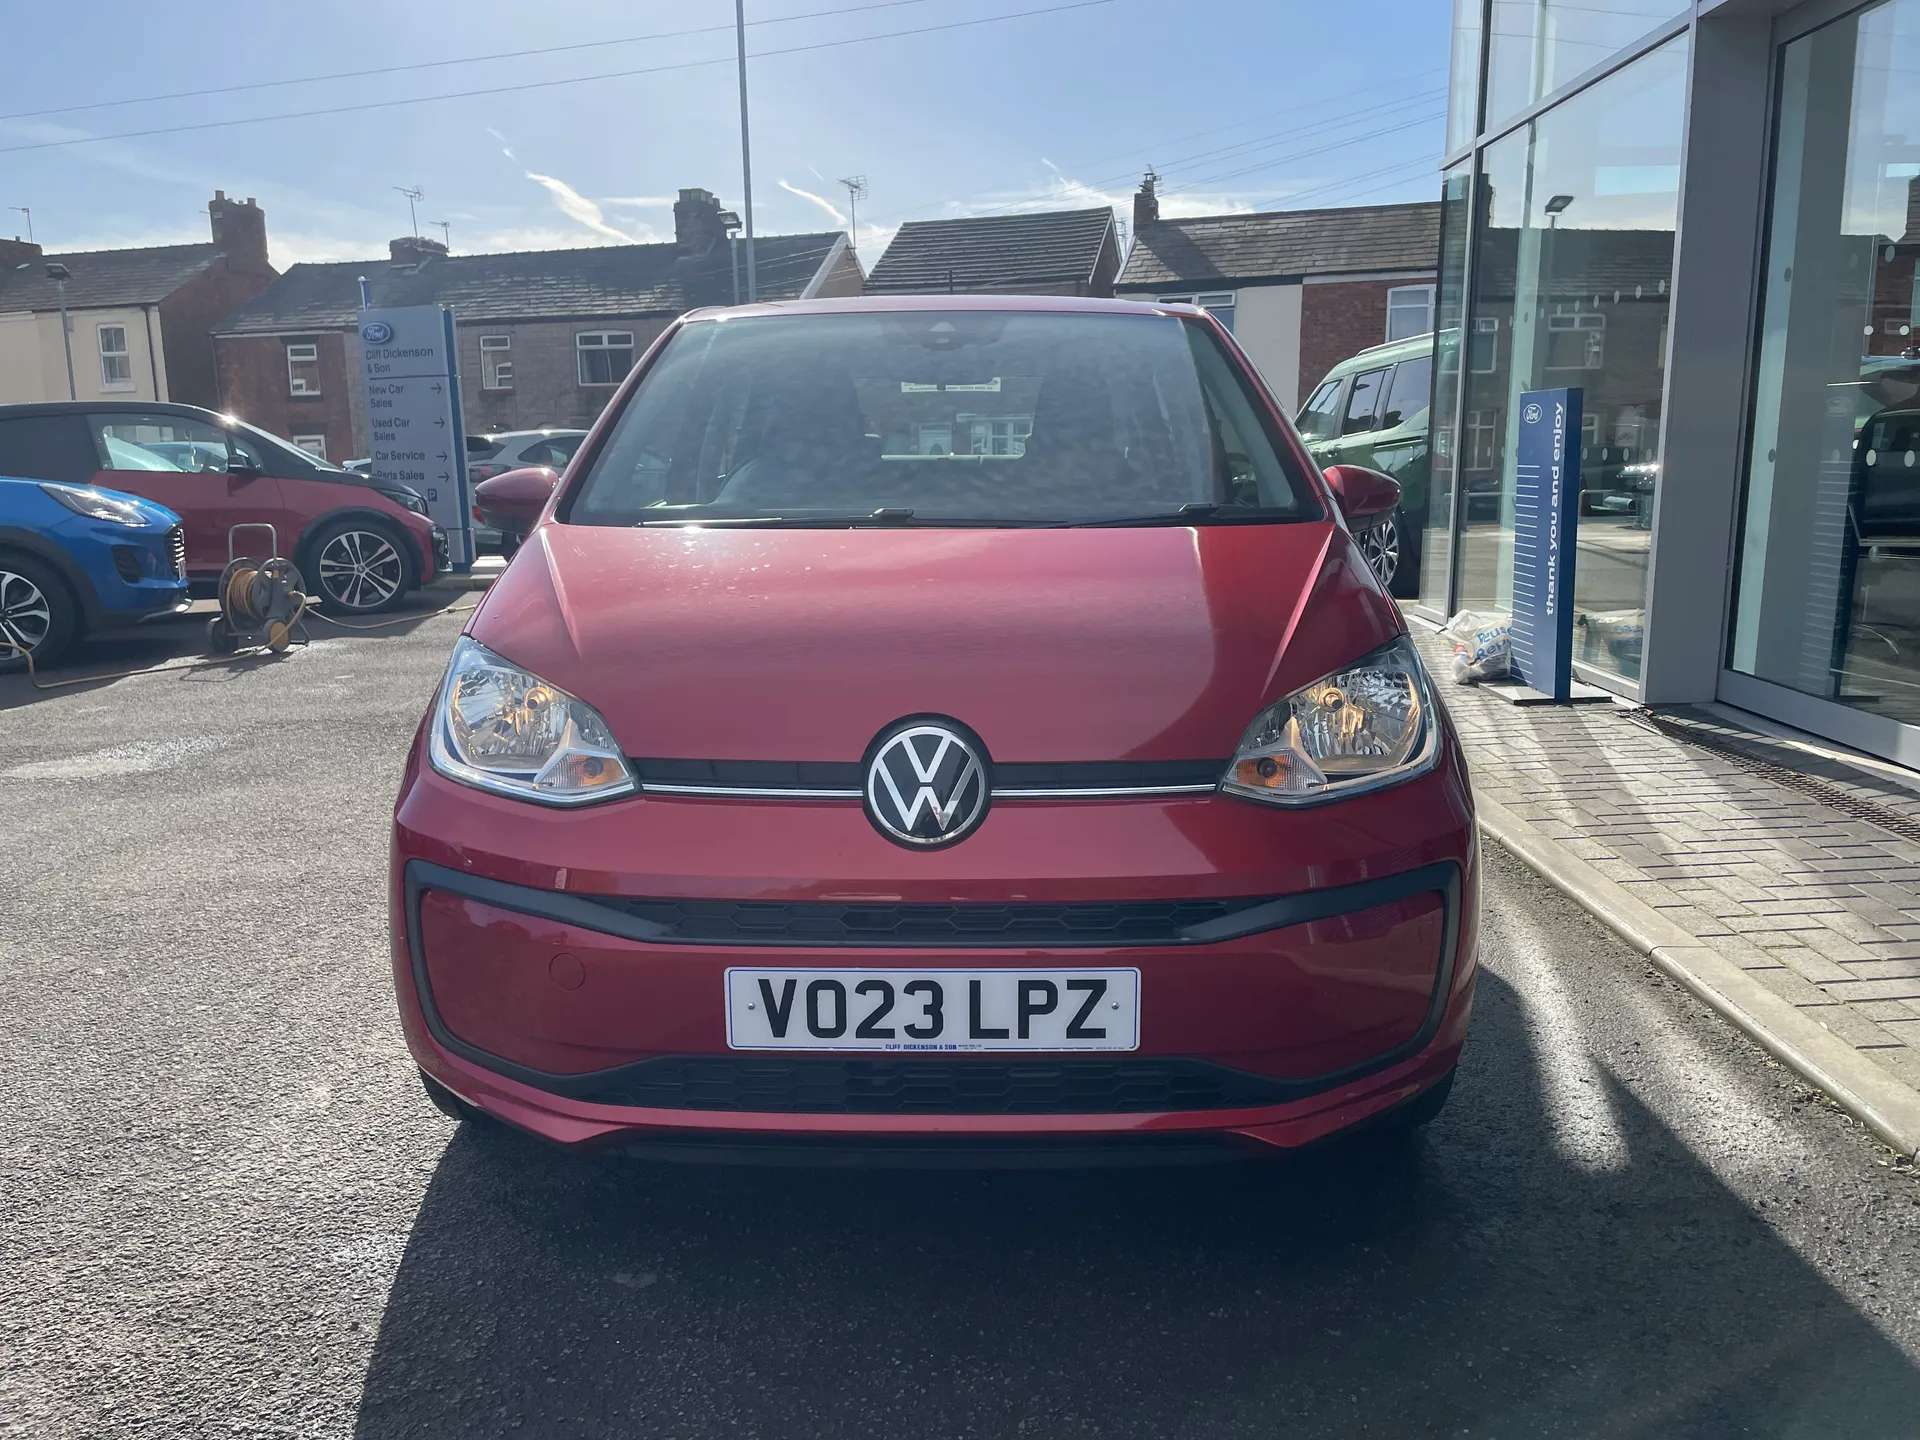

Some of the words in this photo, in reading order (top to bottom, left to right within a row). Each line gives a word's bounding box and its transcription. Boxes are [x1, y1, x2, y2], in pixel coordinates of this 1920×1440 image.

[383, 348, 434, 359] Dickenson
[374, 363, 391, 373] Son
[369, 385, 387, 394] New
[388, 384, 404, 394] Car
[370, 399, 393, 409] Sales
[372, 417, 392, 428] Used
[394, 417, 410, 428] Car
[374, 432, 396, 441] Sales
[1552, 402, 1564, 461] enjoy
[376, 451, 390, 461] Car
[391, 451, 425, 461] Service
[399, 471, 425, 481] Sales
[1551, 465, 1560, 508] and
[1549, 511, 1558, 550] you
[1546, 554, 1556, 616] thank
[758, 978, 944, 1039] VO23
[969, 979, 1107, 1039] LPZ
